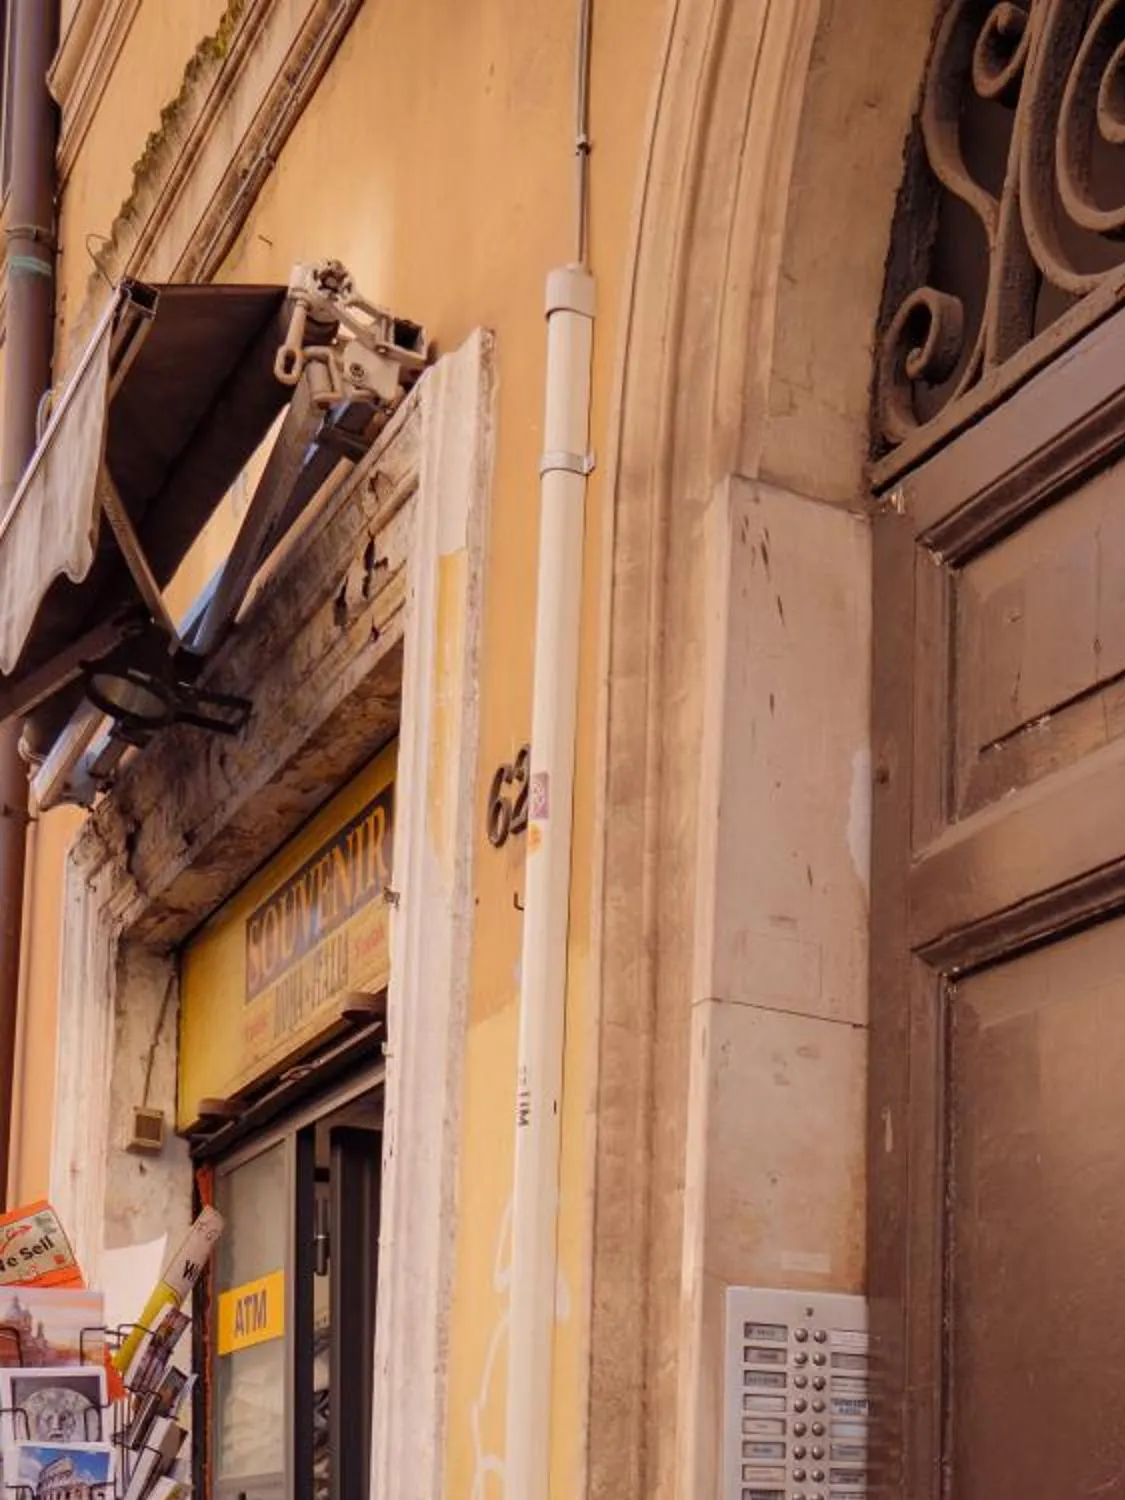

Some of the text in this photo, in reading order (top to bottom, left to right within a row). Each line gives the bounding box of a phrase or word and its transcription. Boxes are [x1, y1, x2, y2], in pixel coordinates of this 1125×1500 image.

[487, 743, 530, 849] 62
[247, 806, 388, 990] SOUVENIR
[19, 1235, 55, 1260] Sell
[234, 1289, 268, 1338] ATM
